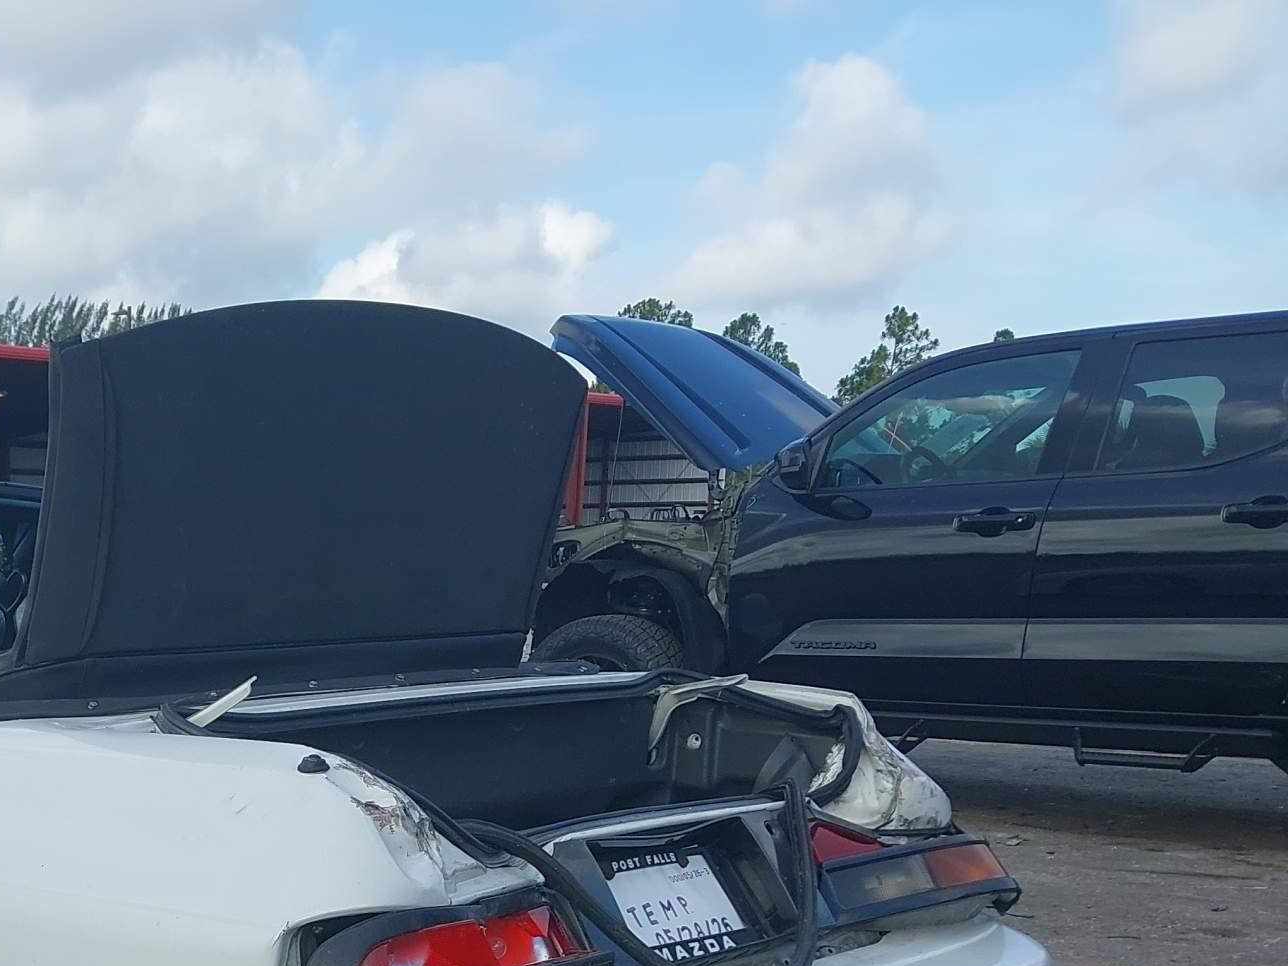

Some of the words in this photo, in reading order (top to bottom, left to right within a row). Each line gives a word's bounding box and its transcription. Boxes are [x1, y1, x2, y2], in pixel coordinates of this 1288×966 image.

[612, 857, 641, 872] POST
[645, 852, 677, 865] FALLS
[626, 896, 690, 928] TEMP
[654, 935, 736, 962] MAZDA
